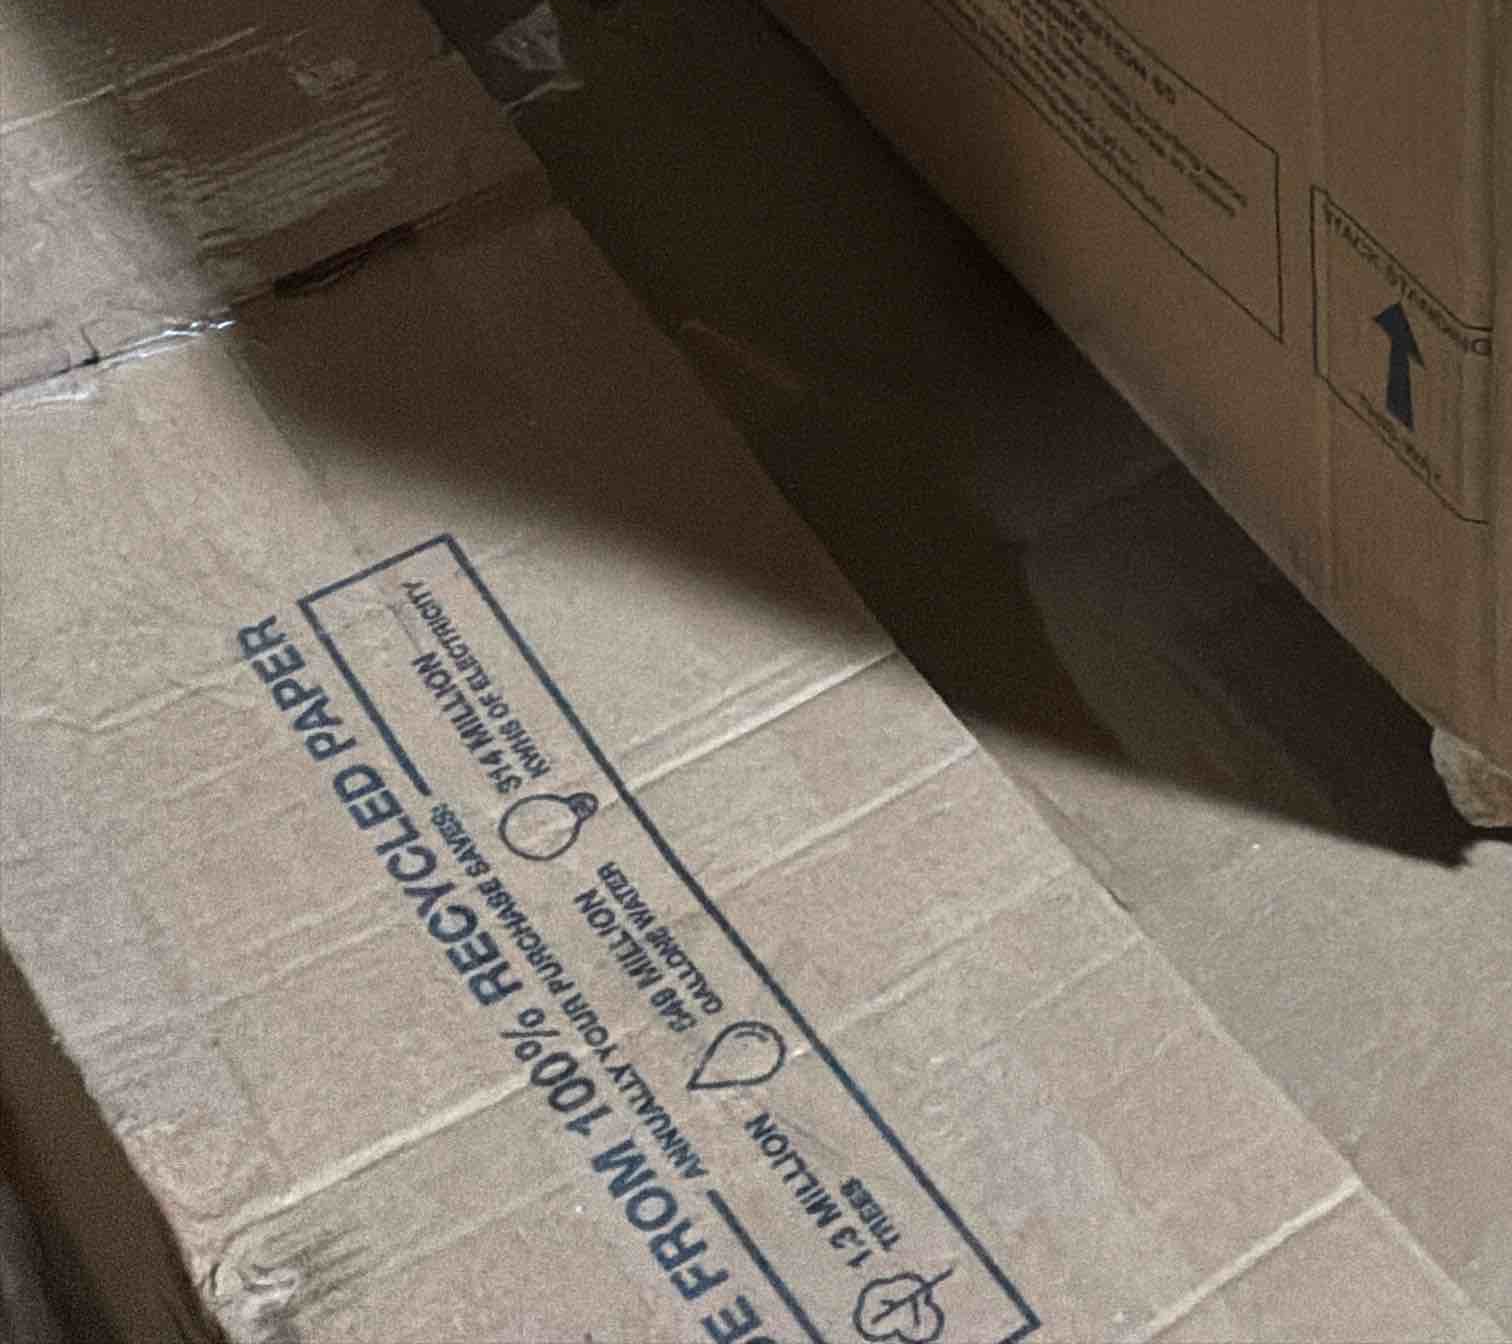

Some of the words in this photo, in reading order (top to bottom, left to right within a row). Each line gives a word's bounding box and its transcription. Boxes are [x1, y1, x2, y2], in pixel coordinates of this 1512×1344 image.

[235, 613, 358, 762] PAPER
[401, 579, 491, 693] ELECTRICITY
[410, 650, 496, 755] MILLION
[478, 694, 510, 719] OF
[478, 749, 523, 795] 314
[331, 762, 525, 1007] RECYCLED
[477, 875, 576, 997] PURCHASE
[572, 886, 665, 991] MILLION
[596, 860, 657, 932] WATER
[500, 1006, 615, 1138] 100%
[560, 991, 621, 1062] YOUR
[605, 1061, 710, 1181] ANNUALLY
[743, 1109, 844, 1230] MILLION
[589, 1135, 730, 1303] FROM
[829, 1225, 875, 1269] 1.3
[839, 1176, 901, 1253] TREES
